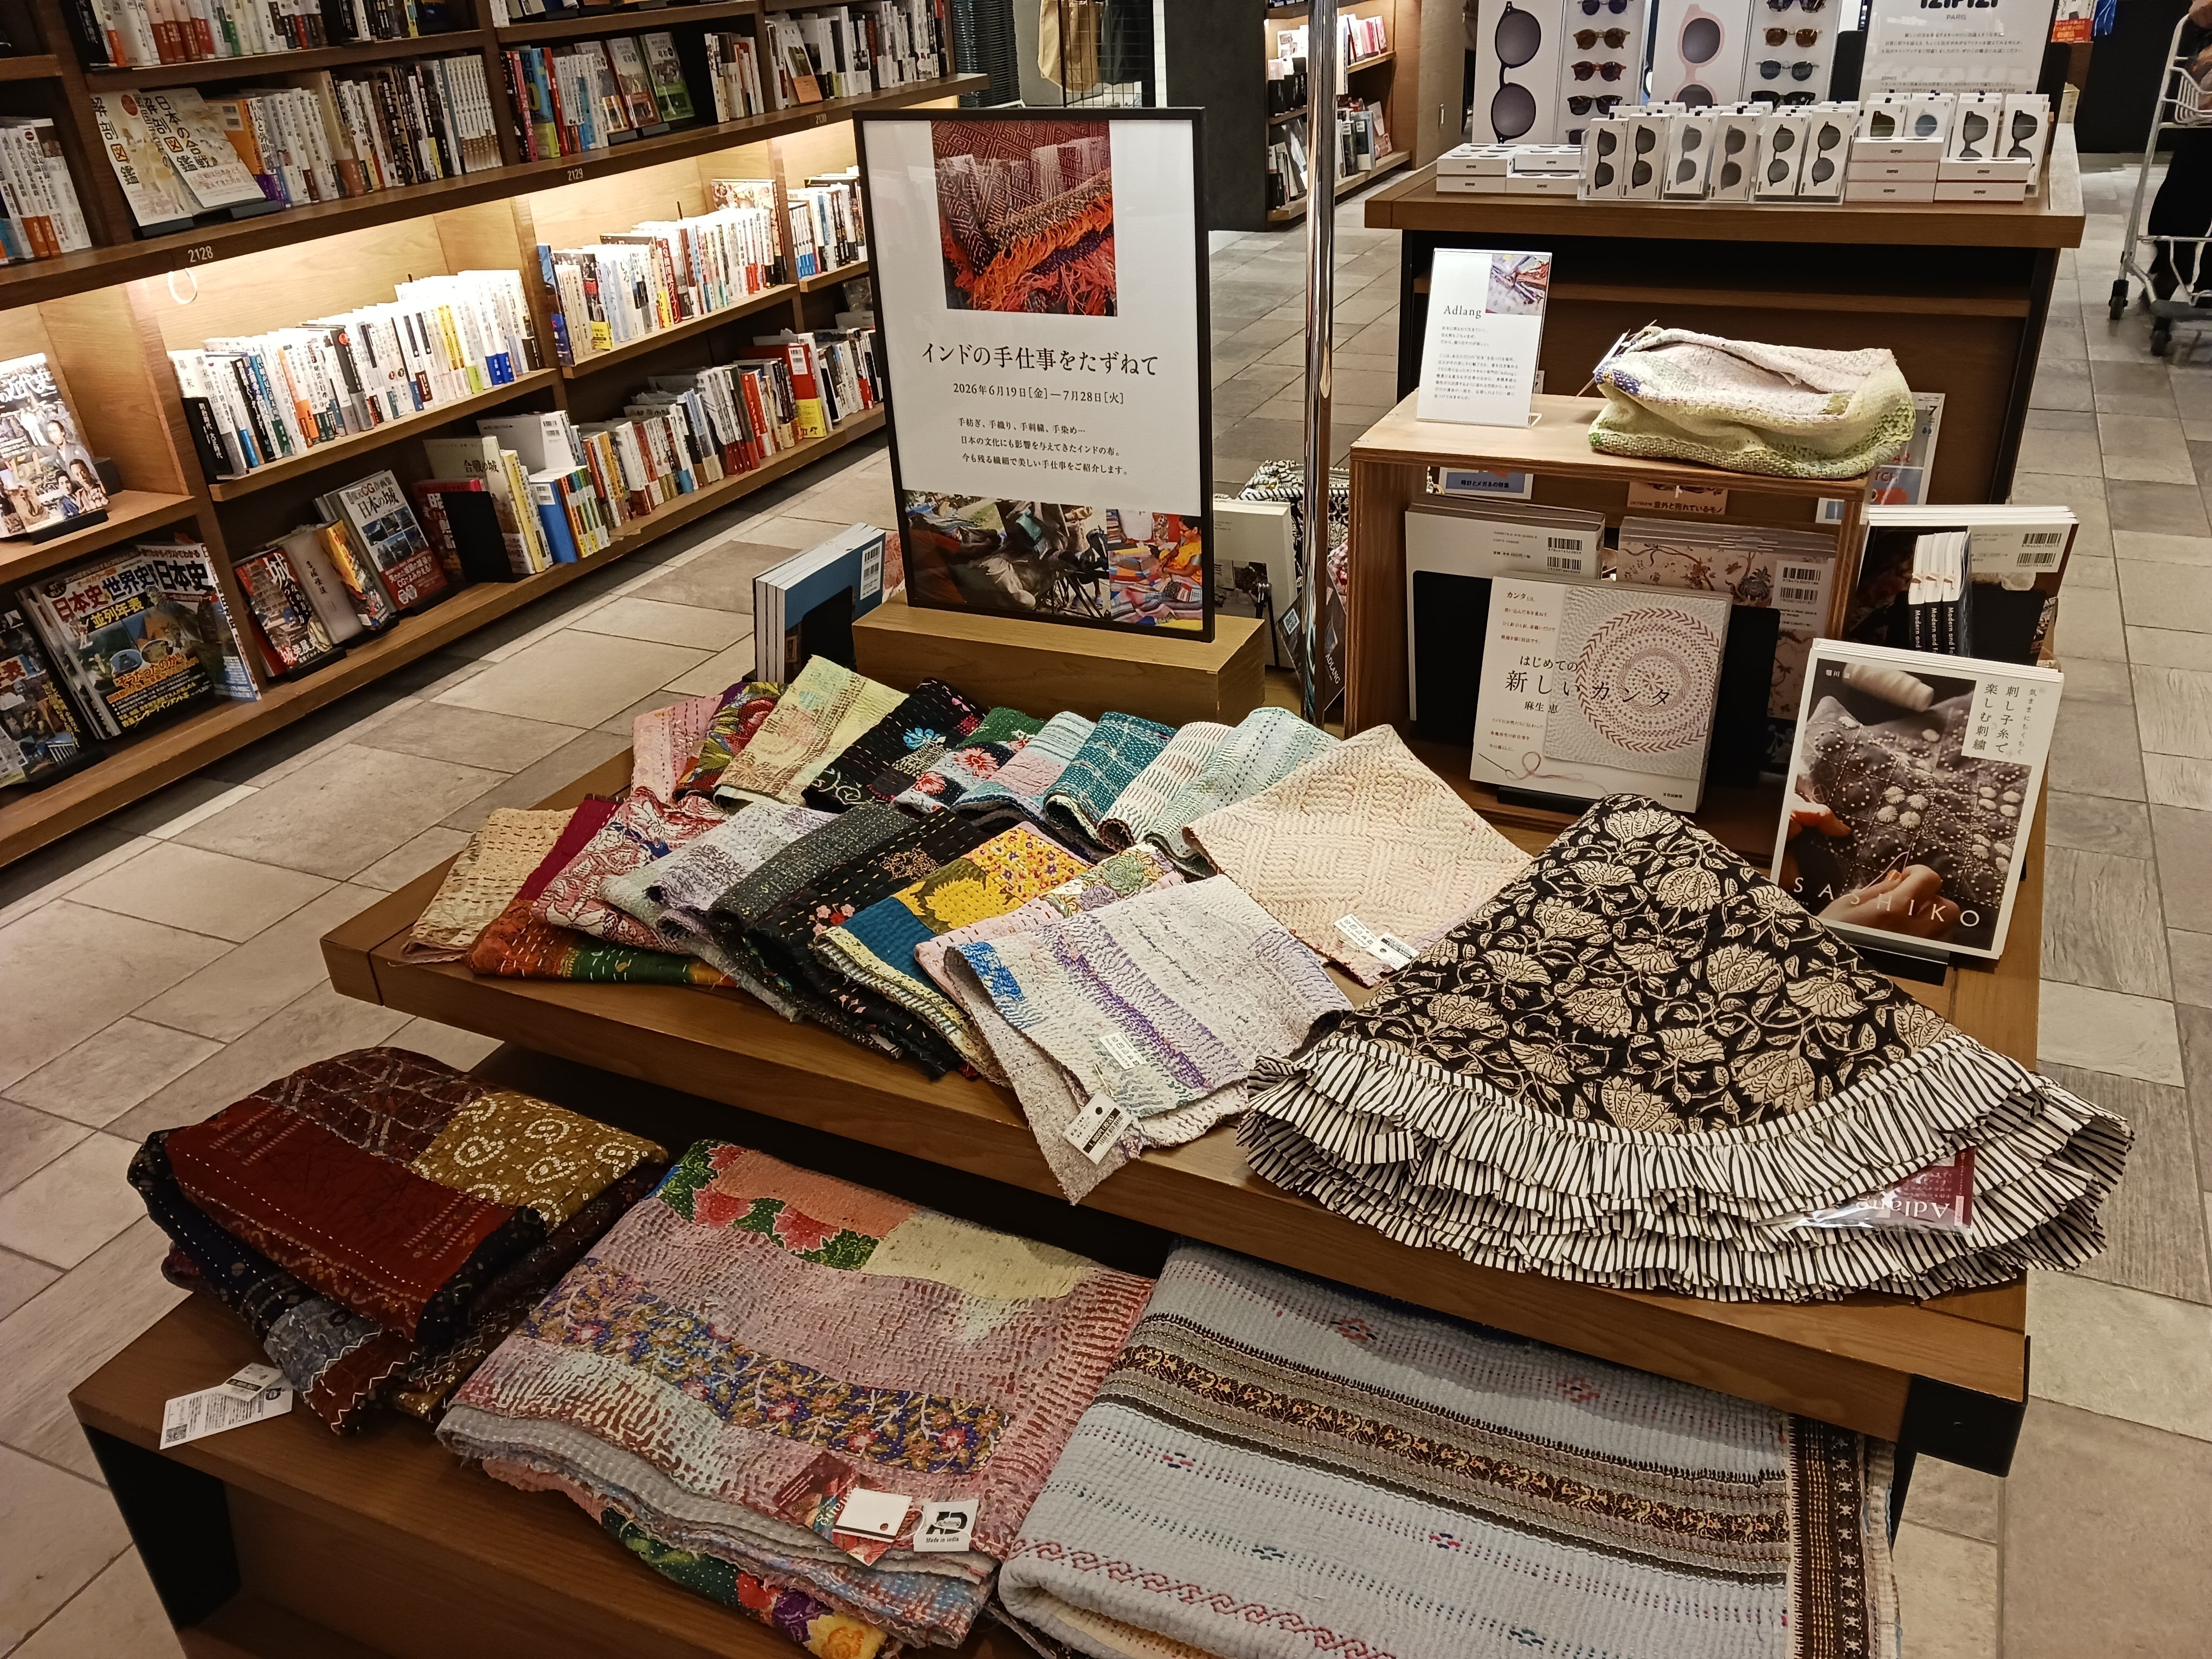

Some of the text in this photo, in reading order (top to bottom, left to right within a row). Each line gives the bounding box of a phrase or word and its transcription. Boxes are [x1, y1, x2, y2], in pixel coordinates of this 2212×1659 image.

[568, 168, 583, 182] 2129
[188, 246, 214, 263] 2128
[1444, 305, 1482, 319] Adlang
[922, 343, 1159, 376] インドの手仕事をたずねて
[961, 436, 1120, 457] 日本の文化にも影響を与えてきたインドの布。
[962, 453, 1128, 476] 今も残る繊細で美しい手仕事をご紹介します。
[357, 487, 400, 519] 日本の城
[91, 596, 145, 629] 並列年表
[1520, 655, 1579, 672] はじめての
[1504, 670, 1670, 708] 新しいカンタ
[1524, 701, 1544, 712] 麻生
[1972, 683, 1998, 751] 楽しむ刺繍
[1996, 686, 2020, 753] 刺し子糸で
[2017, 689, 2037, 755] 気ままにちくちく
[1793, 877, 1979, 927] SASHIKO
[1856, 1195, 1950, 1219] Adlang
